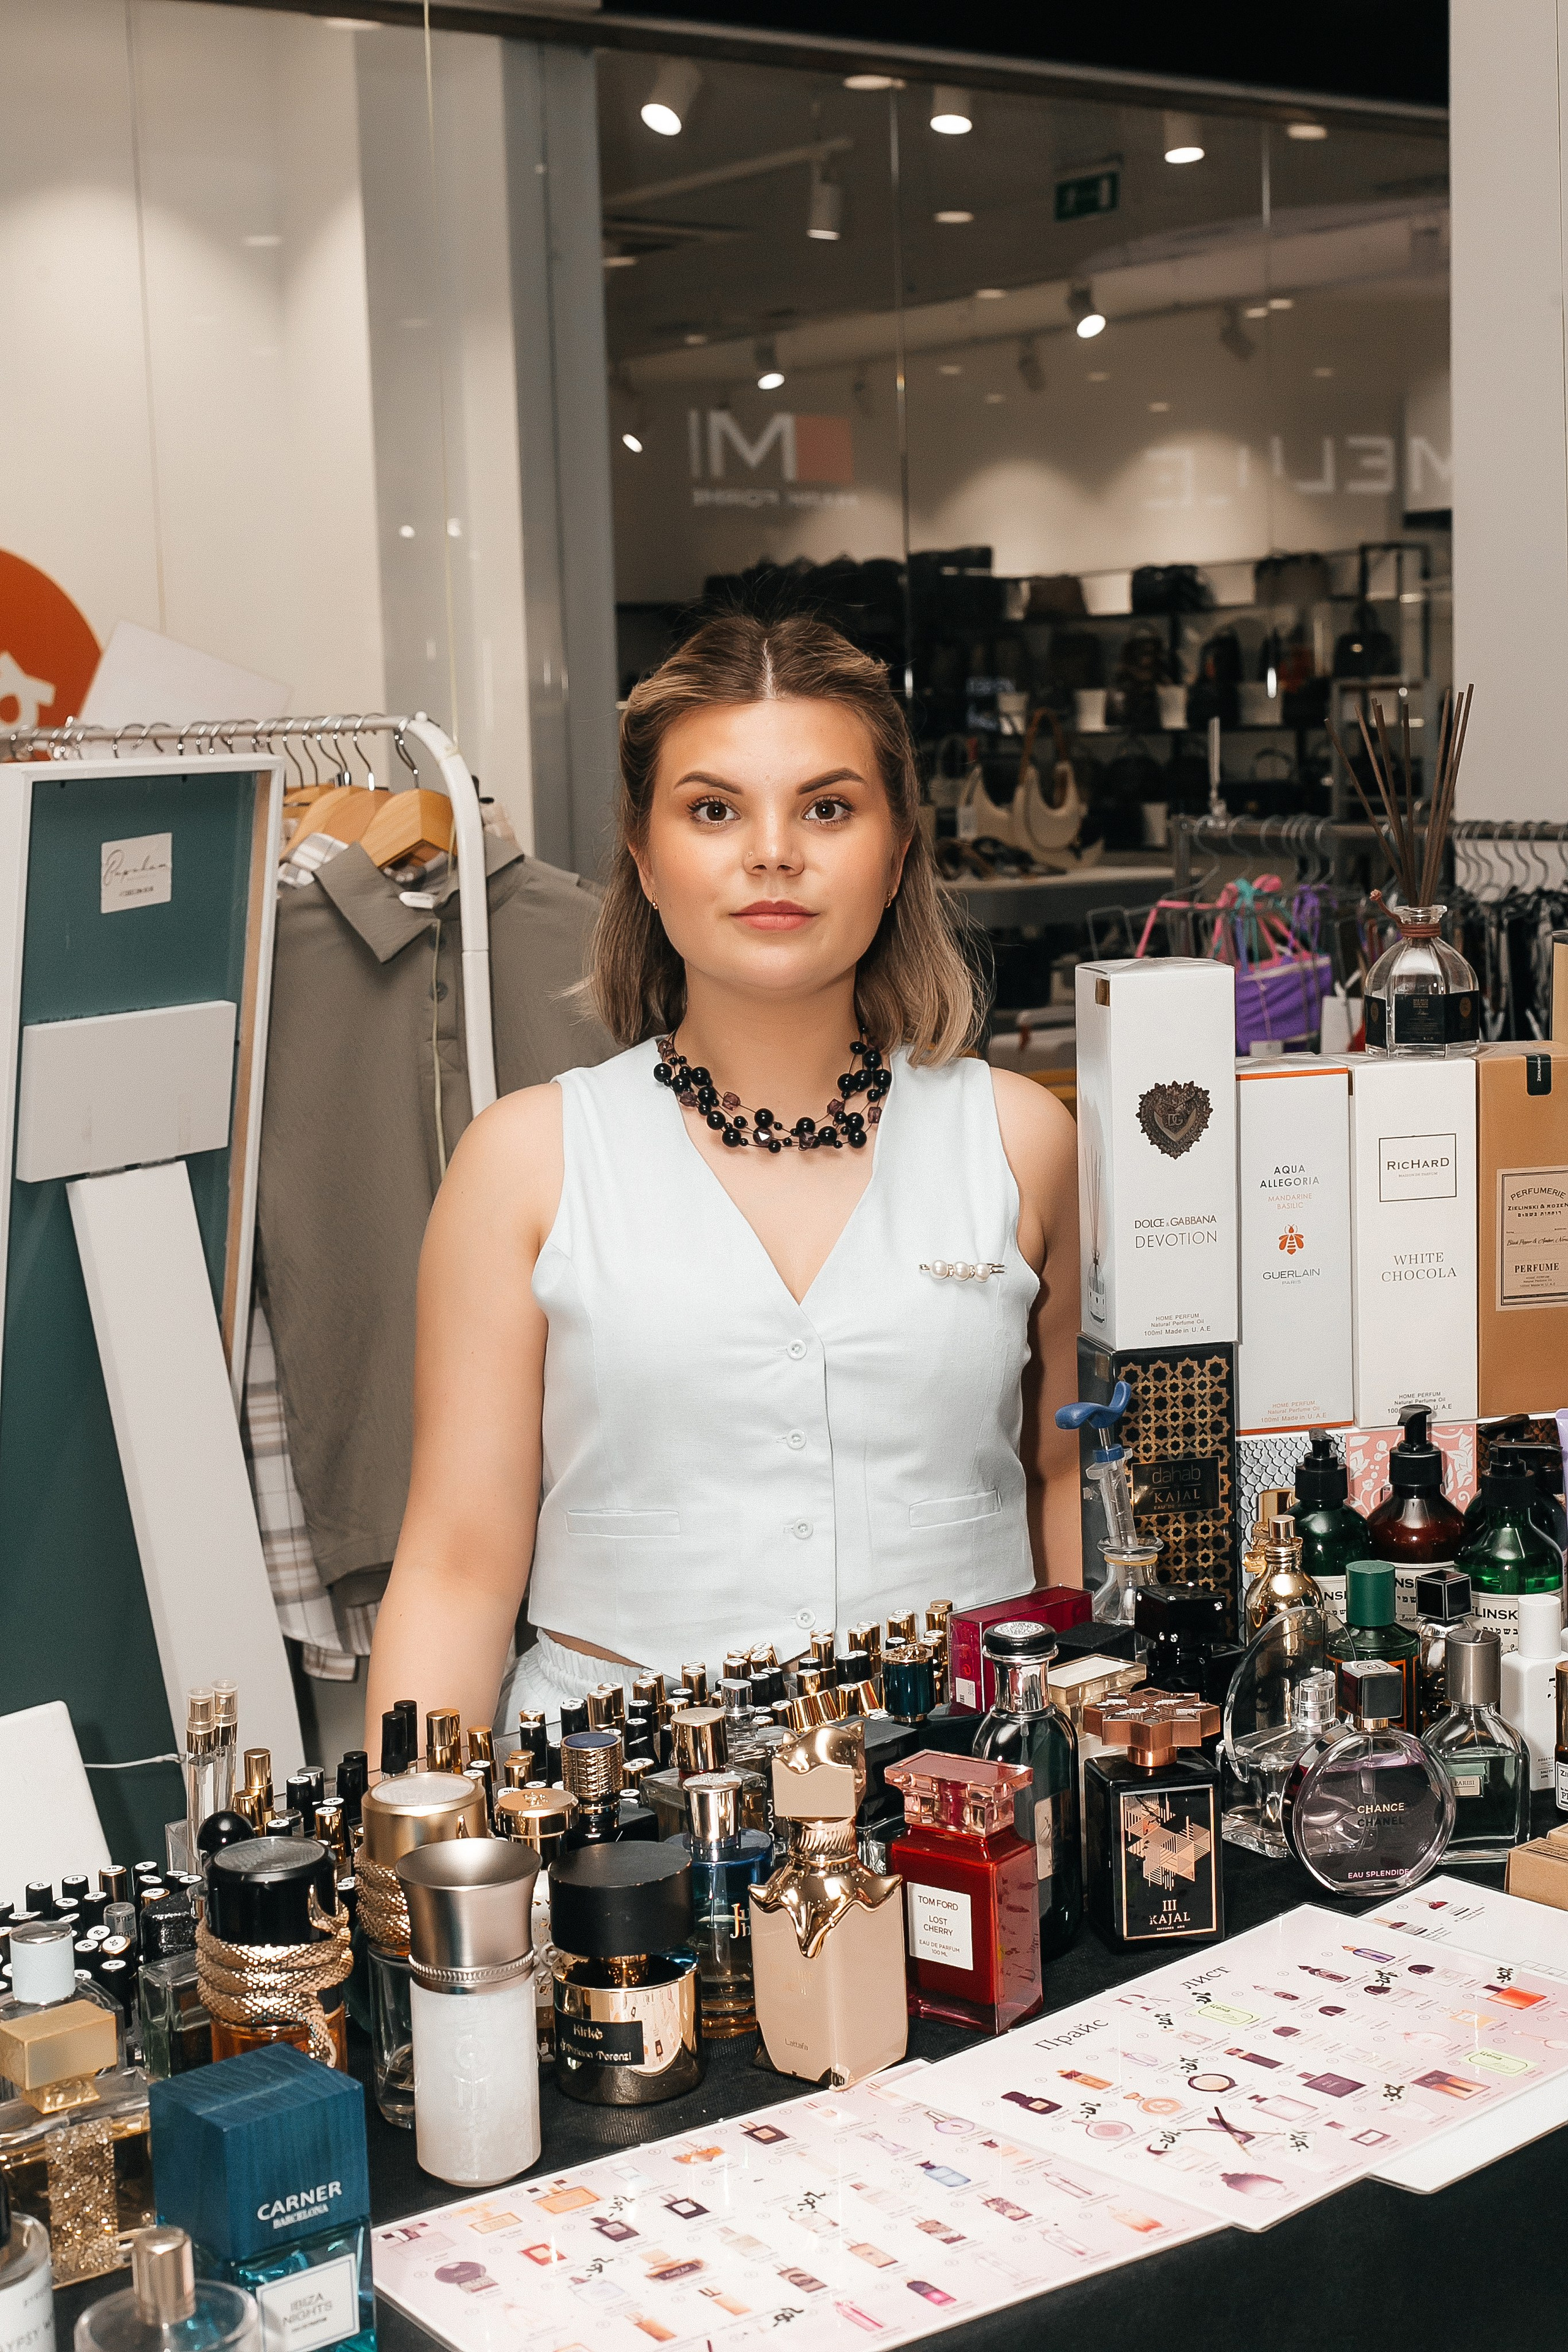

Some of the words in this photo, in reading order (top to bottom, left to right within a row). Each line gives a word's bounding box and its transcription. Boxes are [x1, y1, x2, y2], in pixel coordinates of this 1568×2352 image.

[1273, 1164, 1306, 1175] AQUA
[1259, 1176, 1320, 1189] ALLEGORIA
[1267, 1193, 1313, 1203] MANDARINE
[1509, 1186, 1567, 1201] PERFUMERIE
[1276, 1202, 1304, 1210] BASILIC
[1169, 1215, 1217, 1227] GABBANA
[1135, 1230, 1218, 1250] DEVOTION
[1393, 1251, 1445, 1266] WHITE
[1262, 1268, 1321, 1281] GUERLAIN
[1381, 1266, 1458, 1283] CHOCOLA
[1514, 1262, 1560, 1273] PERFUME
[1152, 1464, 1201, 1484] dahab
[1154, 1488, 1200, 1504] KAJAL
[1357, 1802, 1405, 1815] CHANCE
[1357, 1815, 1405, 1828] CHANEL
[1348, 1871, 1364, 1880] EAU
[1365, 1868, 1409, 1878] SPLENDIDE
[918, 1894, 936, 1907] TOM
[936, 1899, 959, 1912] FORD
[1162, 1899, 1177, 1912] III
[929, 1915, 948, 1926] LOST
[1148, 1911, 1191, 1926] KAJAL
[923, 1923, 954, 1937] CHERRY
[938, 1943, 960, 1953] PARFUM
[1033, 2019, 1109, 2051] Прайс
[784, 2037, 809, 2051] Lattafa
[257, 2180, 342, 2221] CARNER
[272, 2203, 329, 2230] BARCELONA
[290, 2291, 324, 2312] IBIZA
[282, 2299, 333, 2327] NIGHTS
